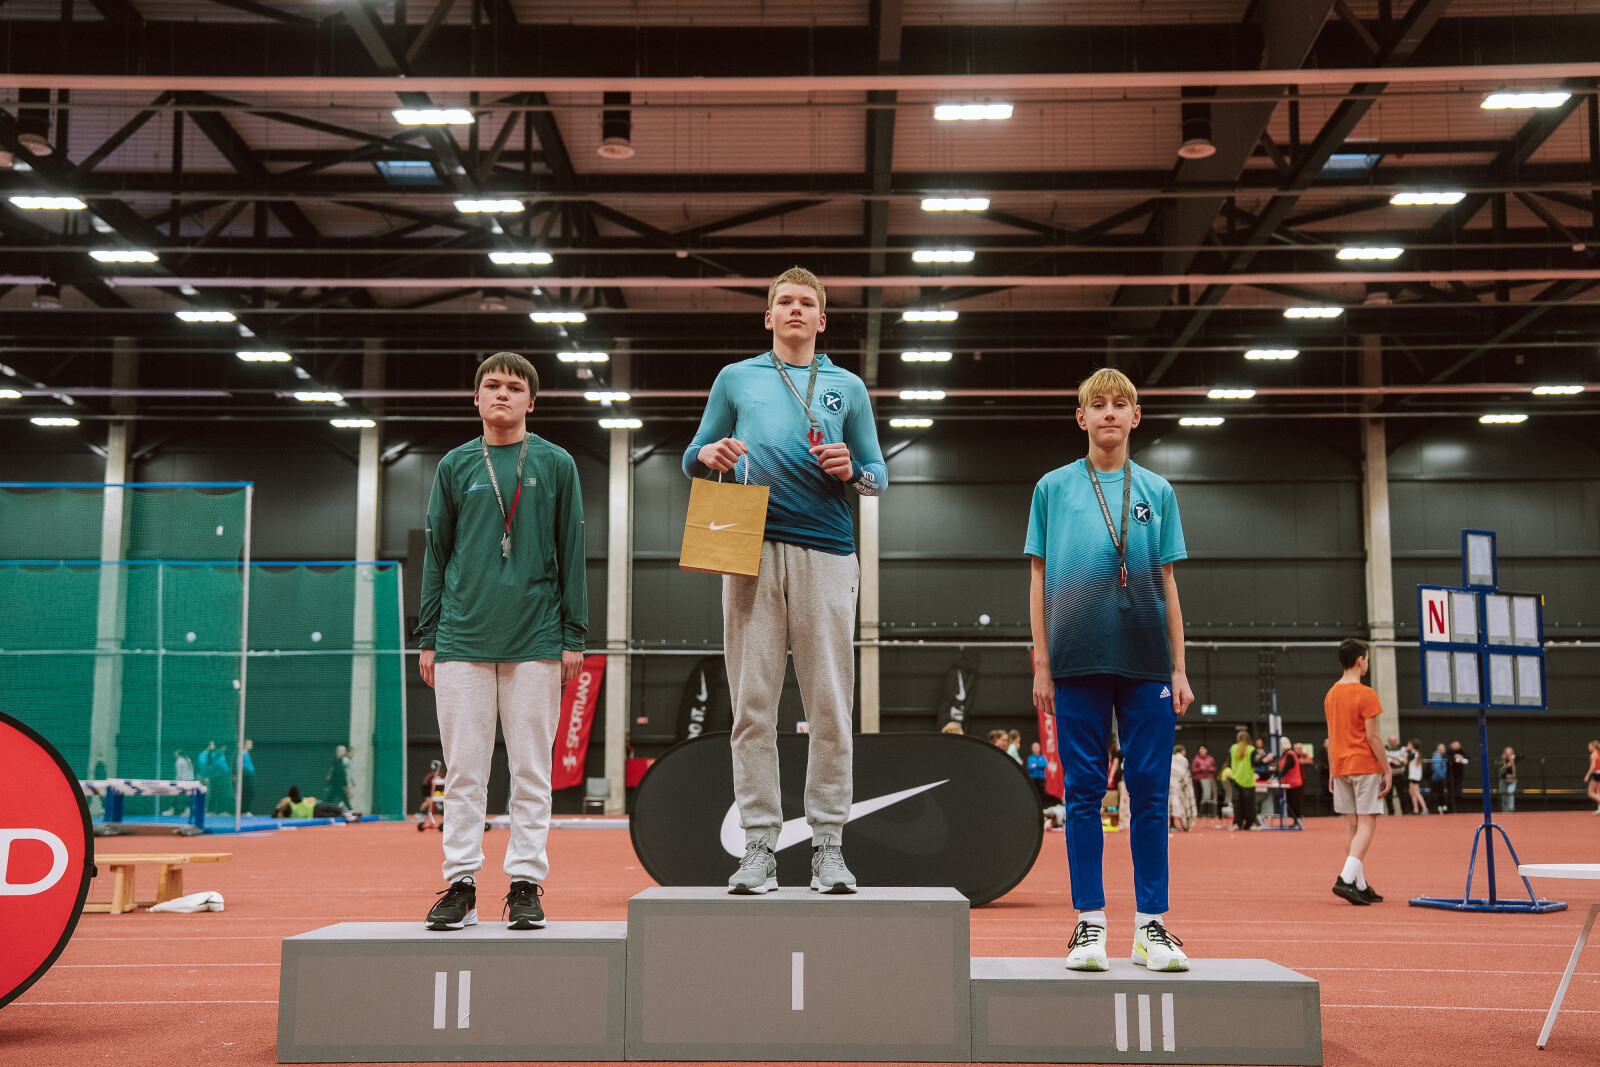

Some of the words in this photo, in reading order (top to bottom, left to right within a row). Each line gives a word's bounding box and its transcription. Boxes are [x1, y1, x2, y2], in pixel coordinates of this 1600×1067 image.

[1428, 600, 1445, 634] N
[566, 671, 592, 749] SPORTLAND
[434, 970, 471, 1029] II
[1114, 993, 1175, 1052] III
